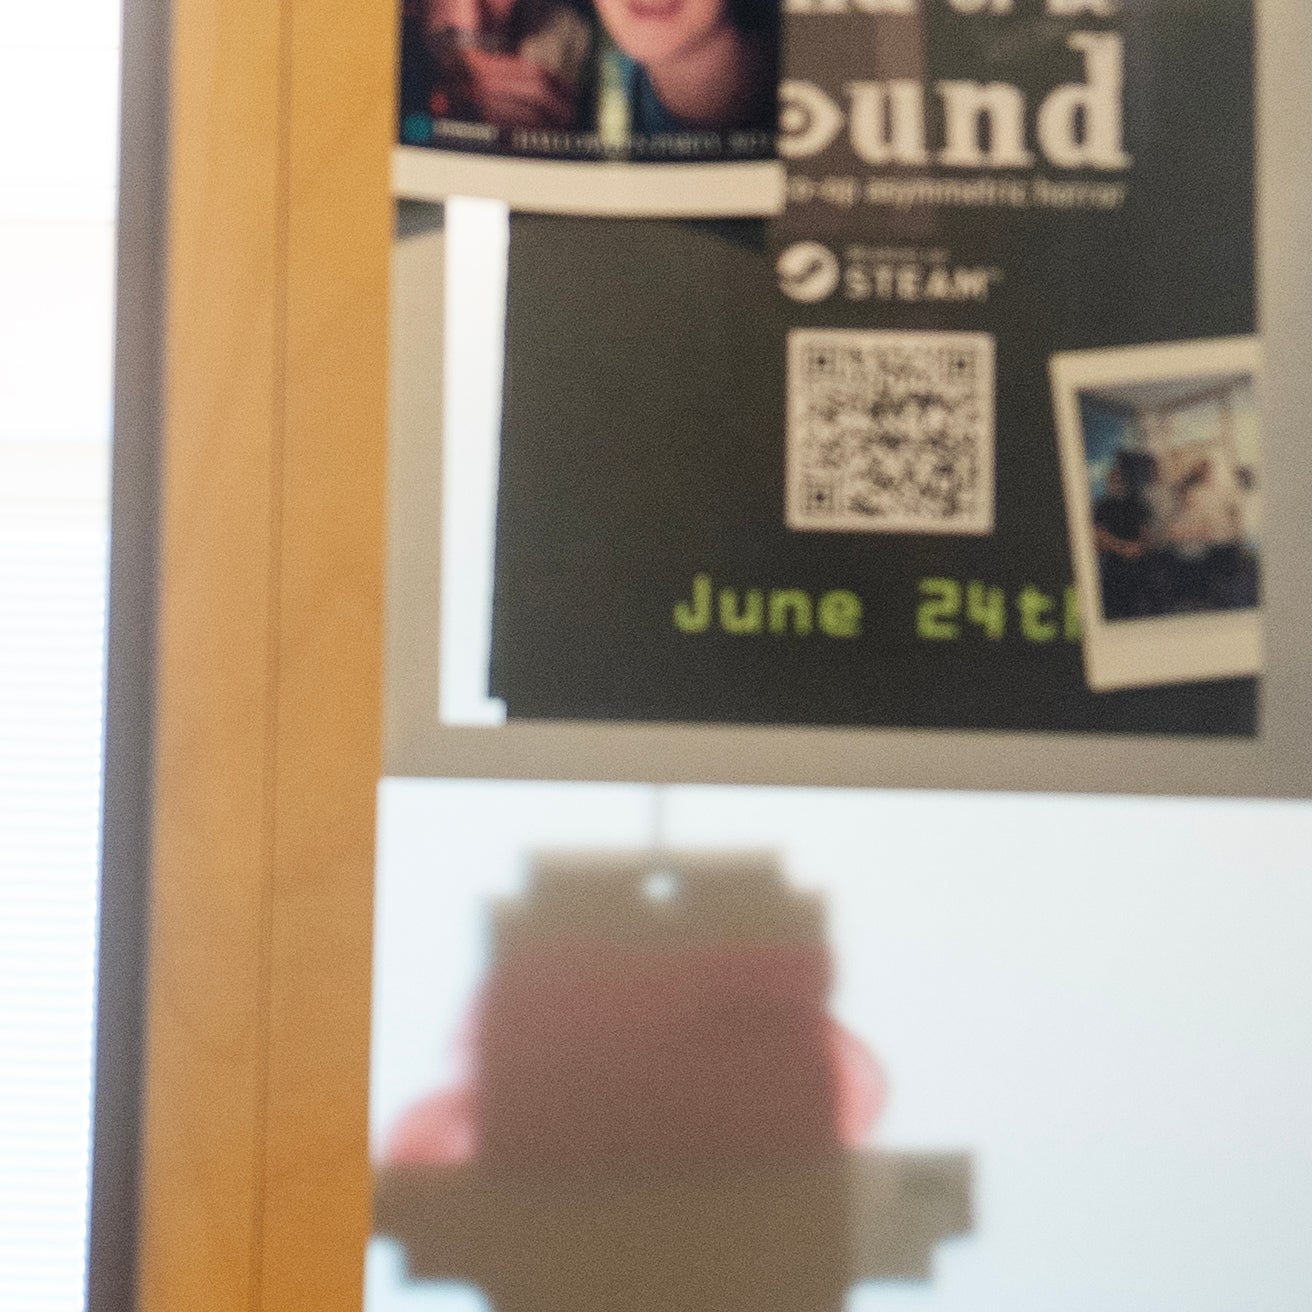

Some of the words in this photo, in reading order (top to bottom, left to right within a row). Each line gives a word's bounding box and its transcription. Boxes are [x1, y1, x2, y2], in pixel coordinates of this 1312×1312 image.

[778, 31, 1133, 169] ound
[785, 176, 857, 208] o-op
[673, 573, 863, 639] June
